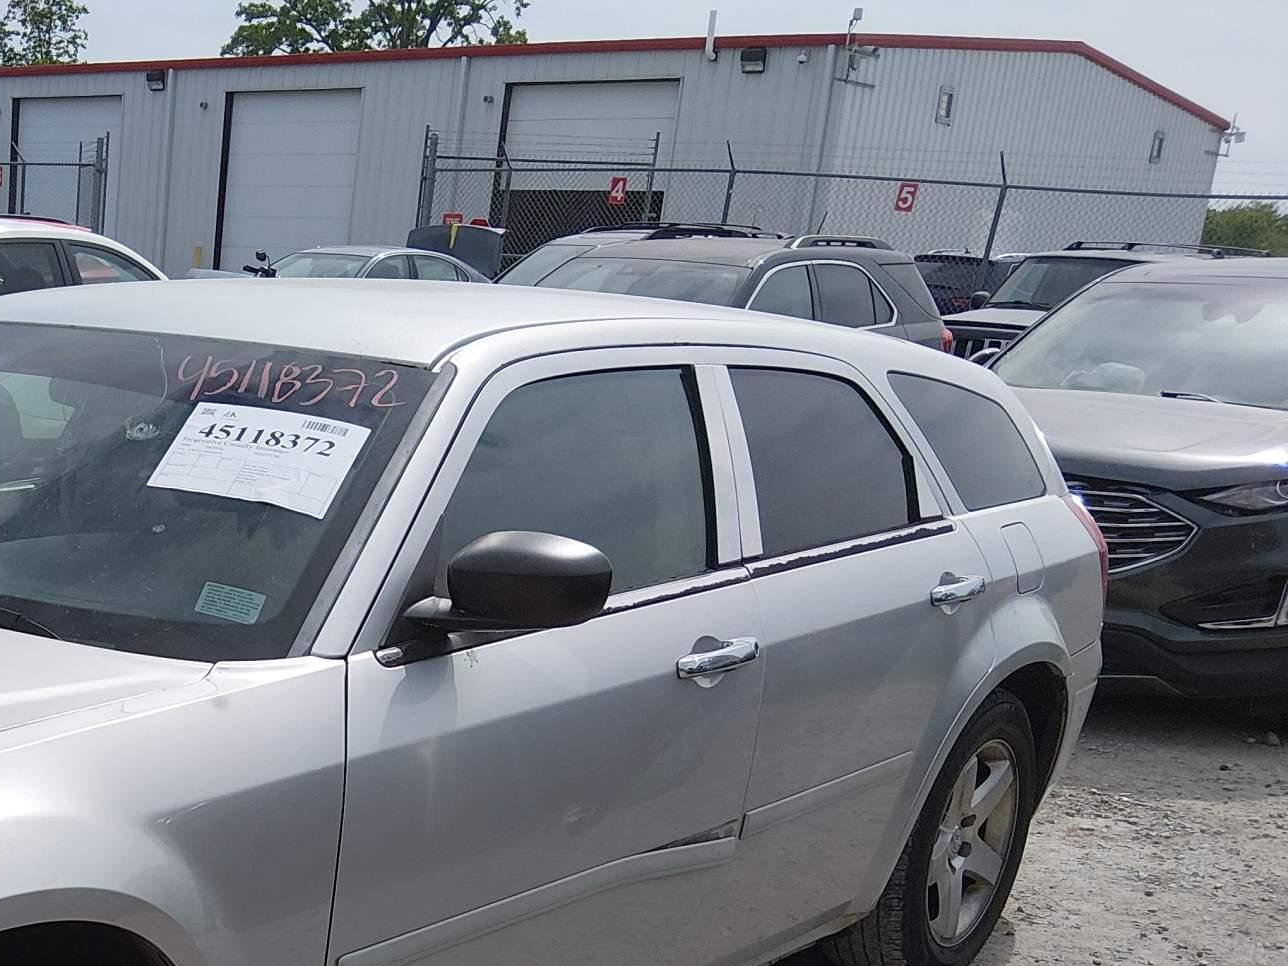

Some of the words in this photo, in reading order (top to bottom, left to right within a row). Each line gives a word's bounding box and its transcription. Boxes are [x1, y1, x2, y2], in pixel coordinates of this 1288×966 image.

[611, 180, 626, 201] 4
[898, 186, 915, 208] 5
[177, 355, 408, 408] 45118372
[198, 422, 337, 457] 45118372
